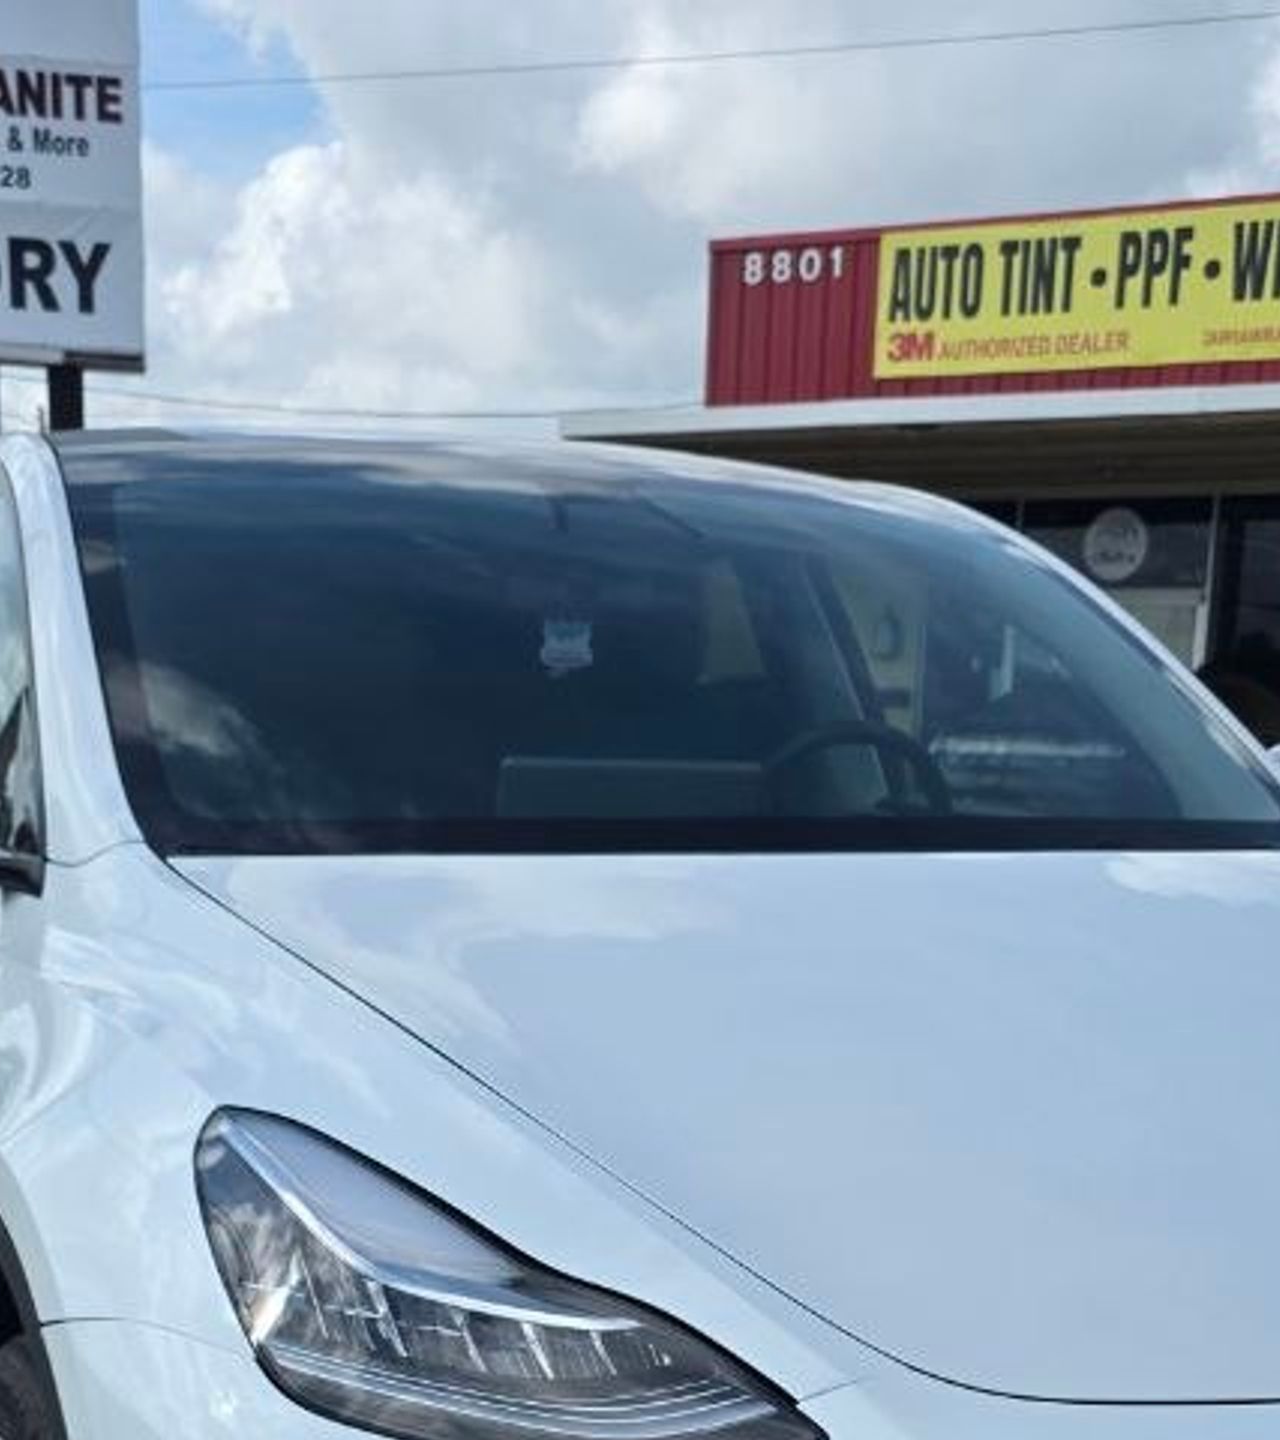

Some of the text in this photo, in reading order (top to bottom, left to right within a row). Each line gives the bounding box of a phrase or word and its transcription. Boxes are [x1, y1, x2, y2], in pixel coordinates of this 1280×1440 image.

[7, 128, 24, 153] &
[33, 128, 89, 157] More
[743, 245, 844, 286] 8801
[888, 242, 984, 323] AUTO
[999, 235, 1082, 317] TINT
[1114, 226, 1194, 310] PPF
[888, 329, 1129, 362] 3M AUTHORIZED DEALER
